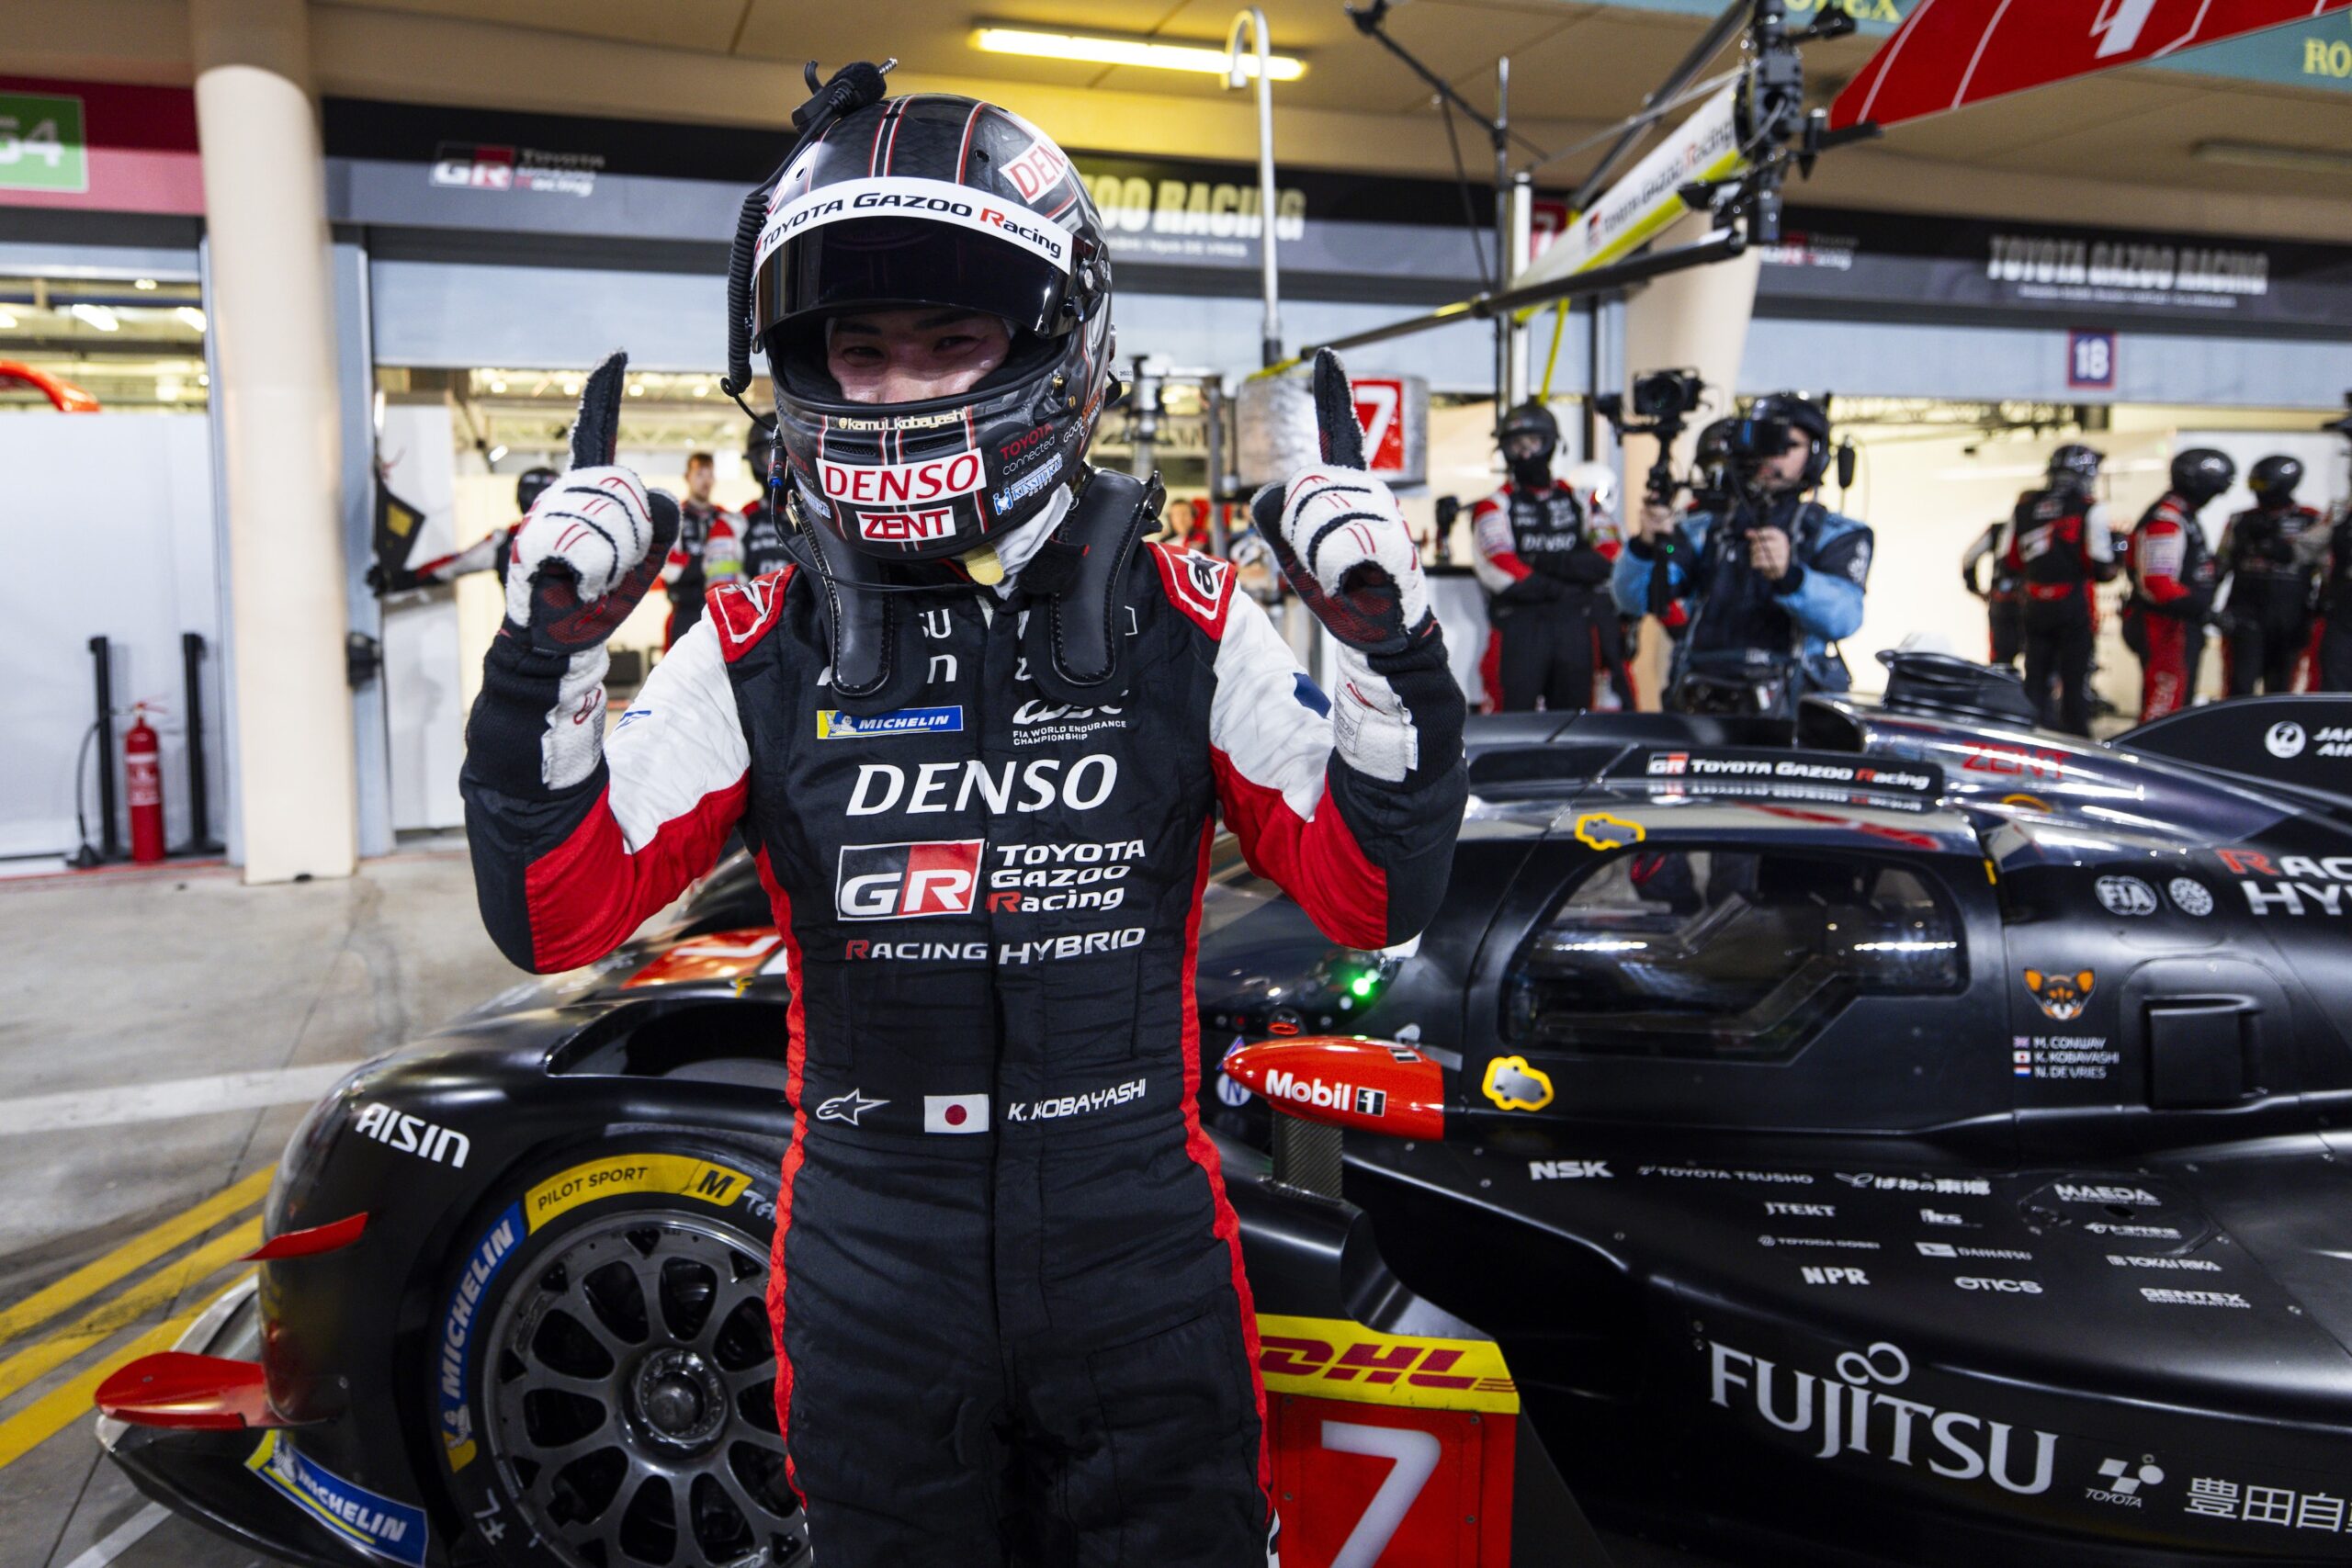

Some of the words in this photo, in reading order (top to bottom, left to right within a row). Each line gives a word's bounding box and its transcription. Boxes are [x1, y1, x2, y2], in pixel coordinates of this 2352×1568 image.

[1009, 144, 1066, 199] DEN
[763, 197, 843, 252] TOYOTA
[853, 192, 972, 217] GAZOO
[979, 208, 1062, 258] Racing
[2075, 336, 2110, 380] 18
[1000, 423, 1054, 461] TOYOTA
[1354, 386, 1397, 465] 7
[1002, 434, 1057, 476] connected
[824, 454, 980, 502] DENSO
[861, 508, 950, 540] ZENT
[858, 714, 950, 730] MICHELIN
[1012, 729, 1029, 739] FIA
[1030, 725, 1067, 737] WORLD
[1069, 719, 1127, 734] ENDURANCE
[1013, 733, 1089, 747] CHAMPIONSHIP
[845, 752, 1118, 817] DENSO
[1647, 759, 1686, 775] GR
[1690, 759, 1773, 775] TOYOTA
[1775, 761, 1855, 782] GAZOO
[1854, 767, 1931, 792] Racing
[996, 839, 1147, 867] TOYOTA
[840, 868, 973, 917] GR
[990, 865, 1131, 889] GAZOO
[986, 887, 1125, 913] Racing
[845, 939, 989, 961] RACING
[998, 927, 1147, 965] HYBRID
[1007, 1102, 1027, 1122] K.
[1030, 1077, 1148, 1121] KOBAYASHI
[1264, 1068, 1352, 1112] Mobil
[356, 1102, 470, 1168] AISIN
[537, 1178, 584, 1212] PILOT
[588, 1167, 649, 1188] SPORT
[696, 1169, 738, 1200] M
[1528, 1161, 1614, 1180] NSK
[1657, 1167, 1732, 1180] TOYOTA
[1734, 1170, 1815, 1185] TSUSHO
[1764, 1201, 1836, 1217] JTEKT
[1801, 1266, 1871, 1285] NPR
[1953, 1275, 2043, 1294] OTICS
[441, 1219, 514, 1399] MICHELIN
[1258, 1335, 1479, 1390] DHL
[1709, 1340, 2061, 1495] FUJITSU
[298, 1469, 408, 1543] MICHELIN
[1321, 1419, 1442, 1568] 7
[2085, 1488, 2143, 1509] TOYOTA
[2184, 1476, 2352, 1533] 豊田自
